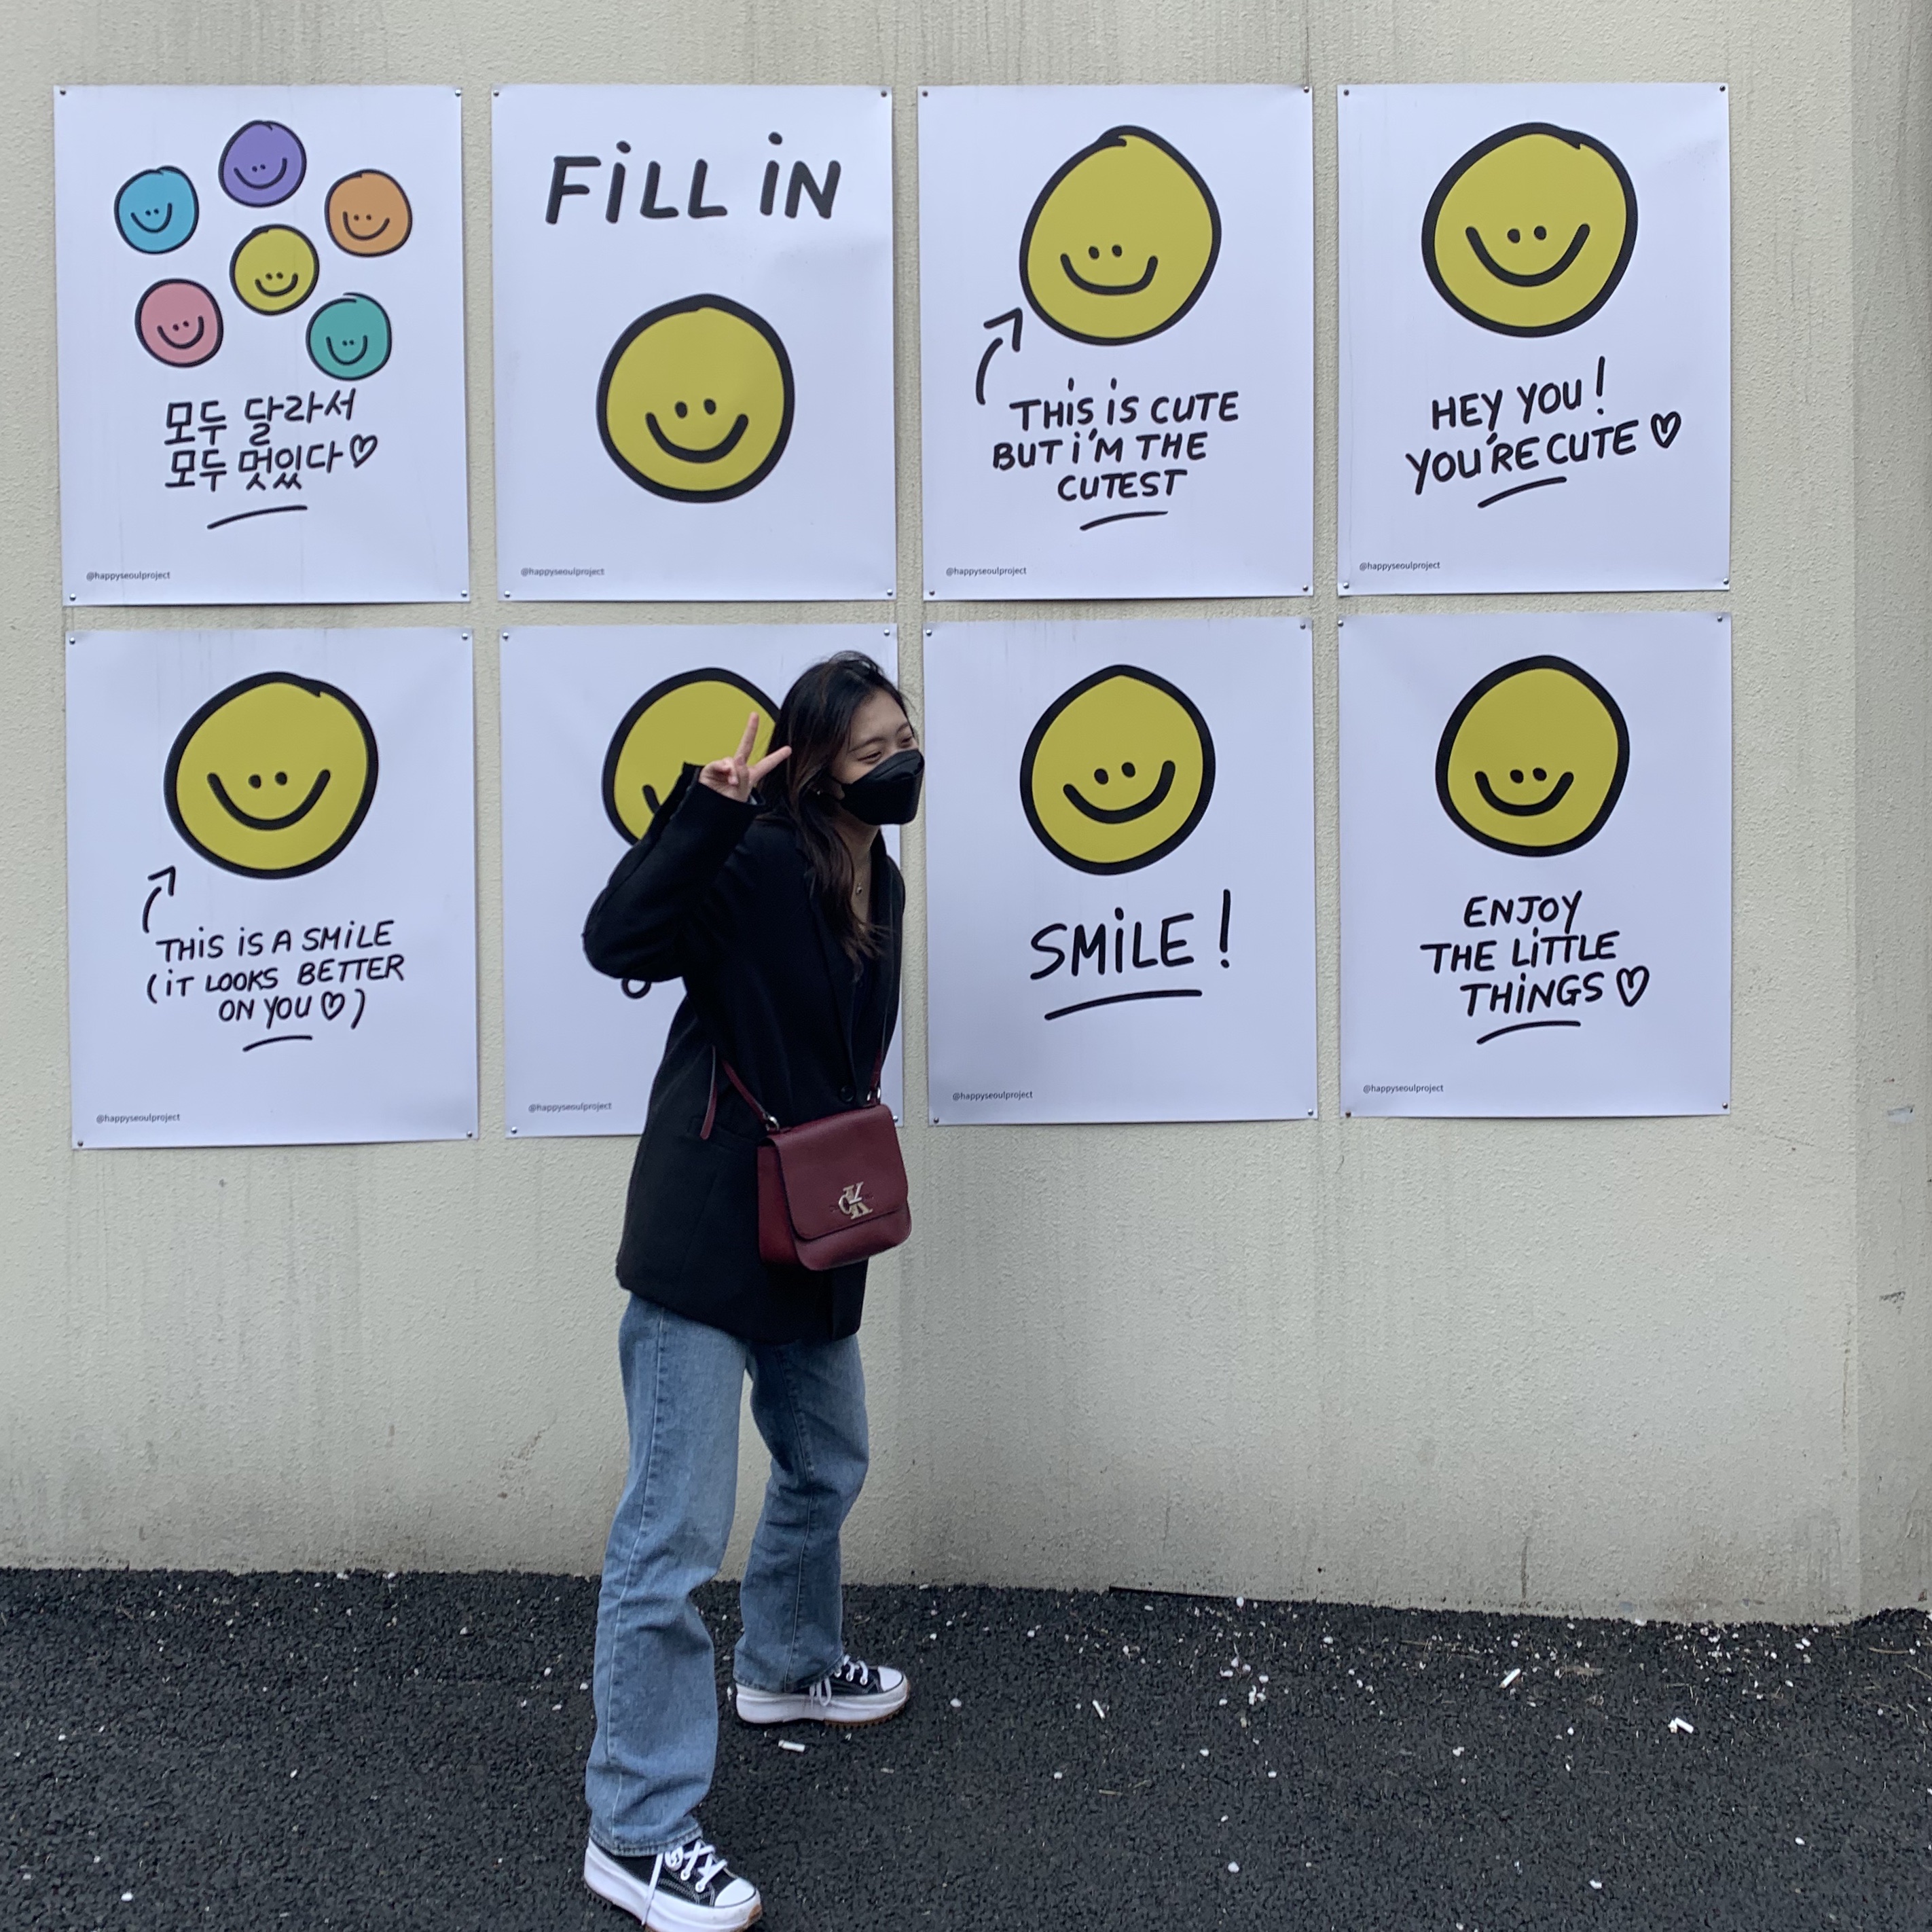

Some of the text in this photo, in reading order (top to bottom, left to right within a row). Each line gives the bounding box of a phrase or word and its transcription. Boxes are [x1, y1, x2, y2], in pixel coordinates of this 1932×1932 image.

[164, 388, 357, 447] 모두 달라서
[1150, 390, 1239, 424] CUTE
[1432, 389, 1503, 432] HEY
[992, 439, 1063, 471] BUT
[1135, 431, 1208, 461] THE
[1546, 420, 1639, 464] CUTE
[164, 440, 344, 492] 모두 멋있다
[1057, 469, 1188, 502] CUTEST
[86, 570, 170, 582] @happyseoulproject
[520, 567, 604, 577] @happyseoulproject
[945, 566, 1027, 577] @happyseoulproject
[1359, 561, 1440, 572] @happyseoulproject
[1463, 890, 1583, 935] ENJOY
[272, 930, 291, 954] A
[1419, 940, 1497, 974] THE
[205, 967, 278, 992] LOOKS
[297, 953, 405, 986] BETTER
[218, 998, 255, 1022] ON
[263, 996, 312, 1029] YOU
[952, 1091, 1033, 1101] @happyseoulproject
[1363, 1083, 1444, 1095] @happyseoulproject
[96, 1113, 181, 1124] @happyseoulproject
[528, 1102, 613, 1113] @happyseoulproject
